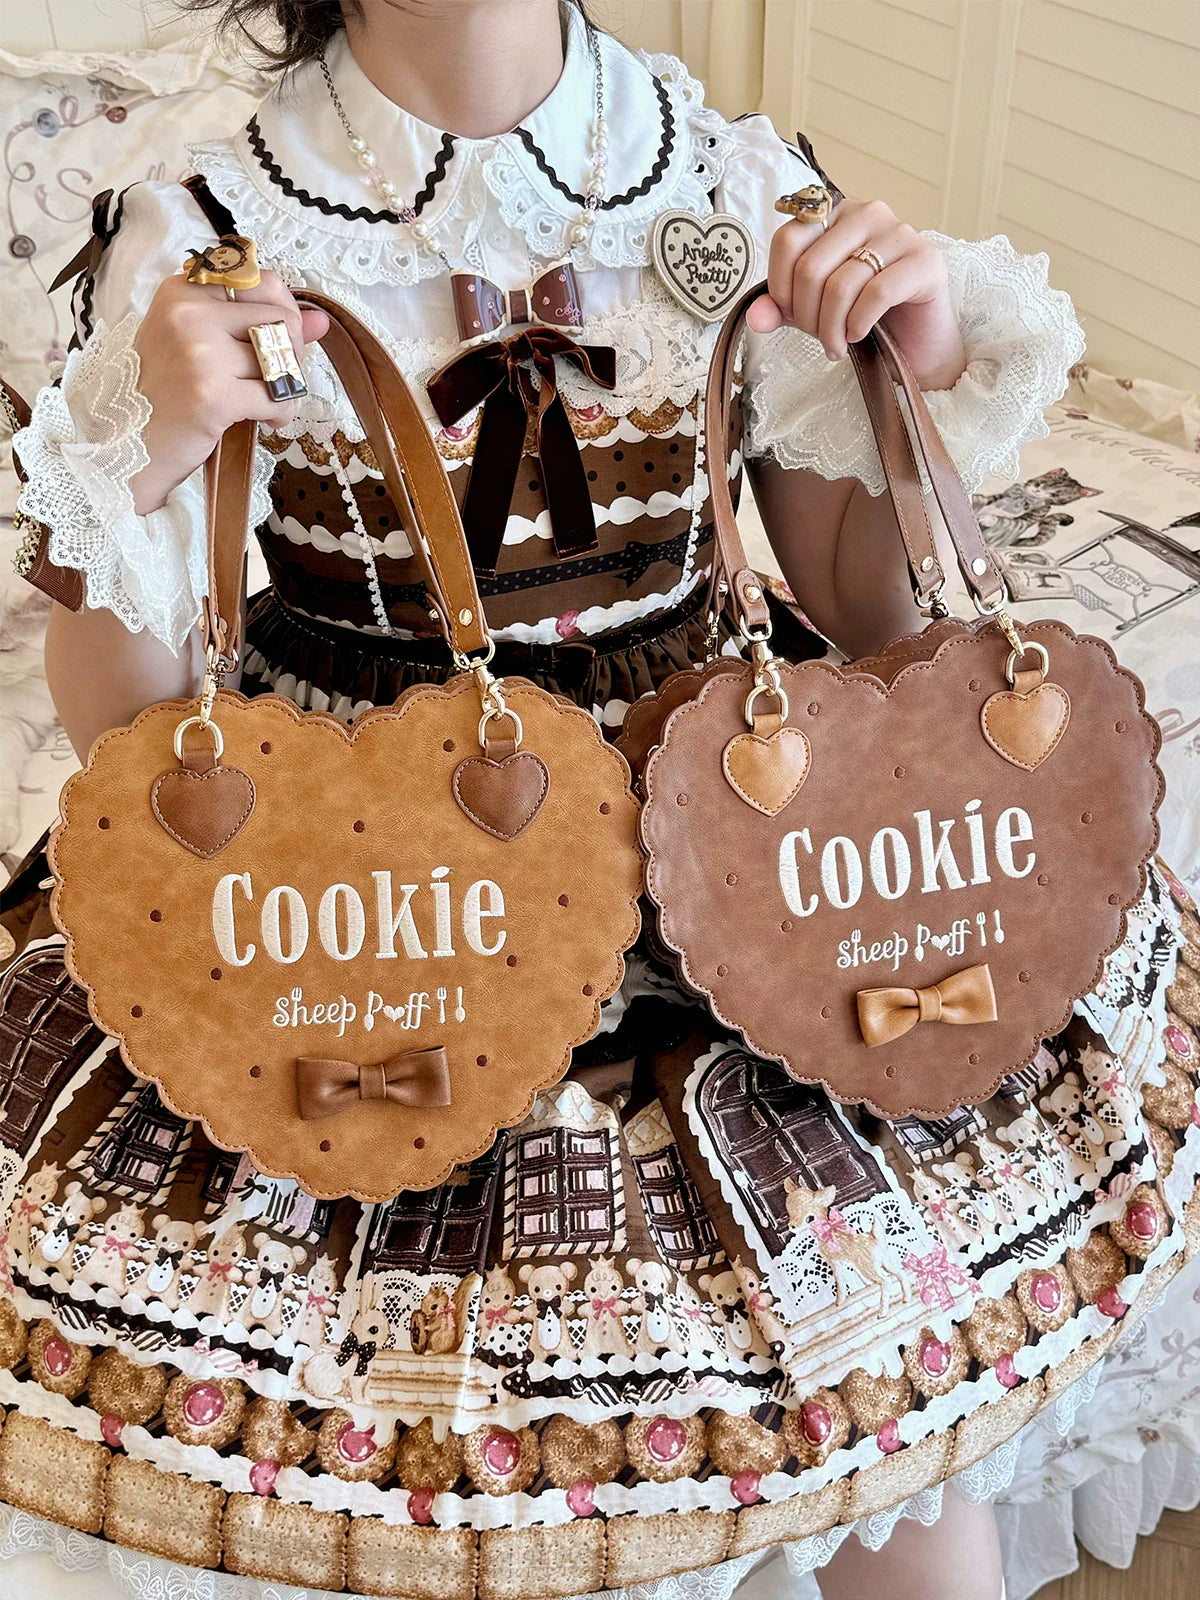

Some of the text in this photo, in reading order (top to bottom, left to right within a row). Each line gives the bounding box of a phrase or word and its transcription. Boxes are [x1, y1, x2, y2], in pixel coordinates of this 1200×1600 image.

[679, 242, 734, 267] Angelic
[685, 263, 732, 294] Pretty
[778, 798, 1036, 917] Cookie
[212, 866, 507, 967] Cookie
